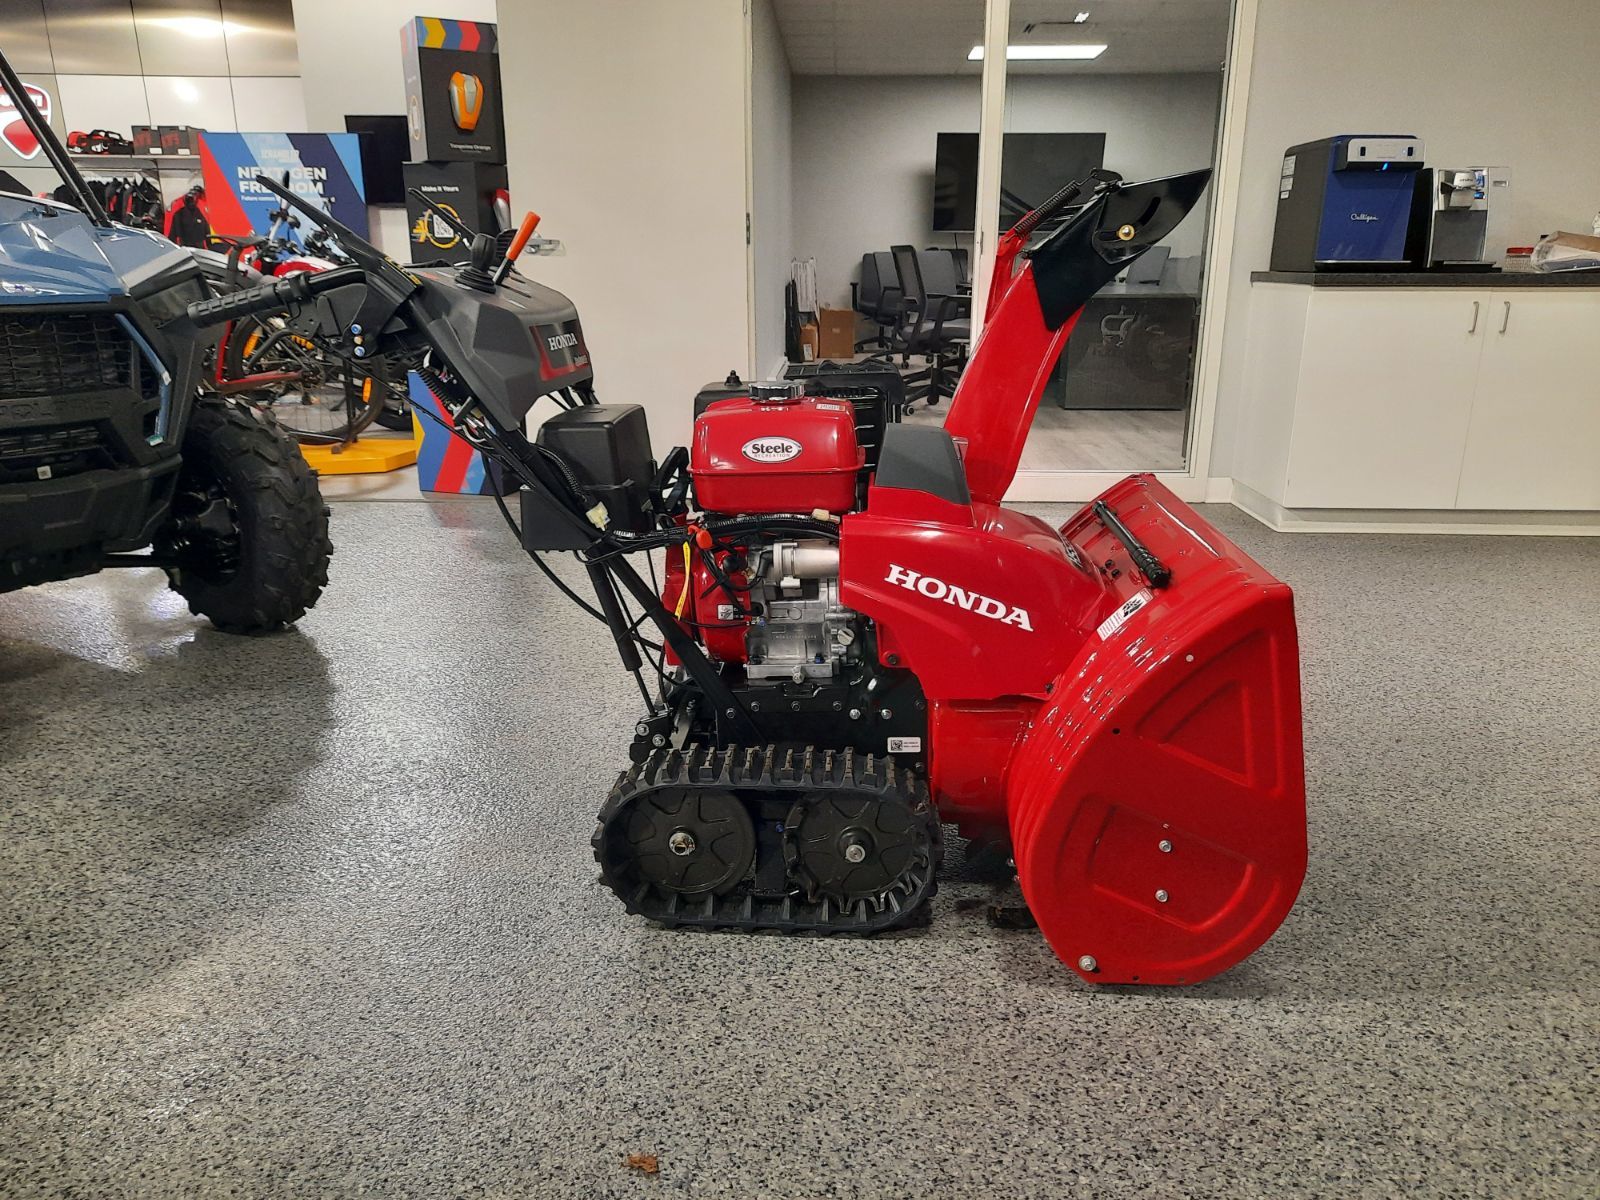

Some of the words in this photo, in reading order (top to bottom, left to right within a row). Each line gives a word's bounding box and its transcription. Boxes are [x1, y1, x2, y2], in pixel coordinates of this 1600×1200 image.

[291, 167, 327, 180] GEN
[1350, 213, 1379, 223] Culligan
[548, 333, 578, 351] HONDA
[751, 443, 793, 454] Steele
[884, 563, 1034, 632] HONDA
